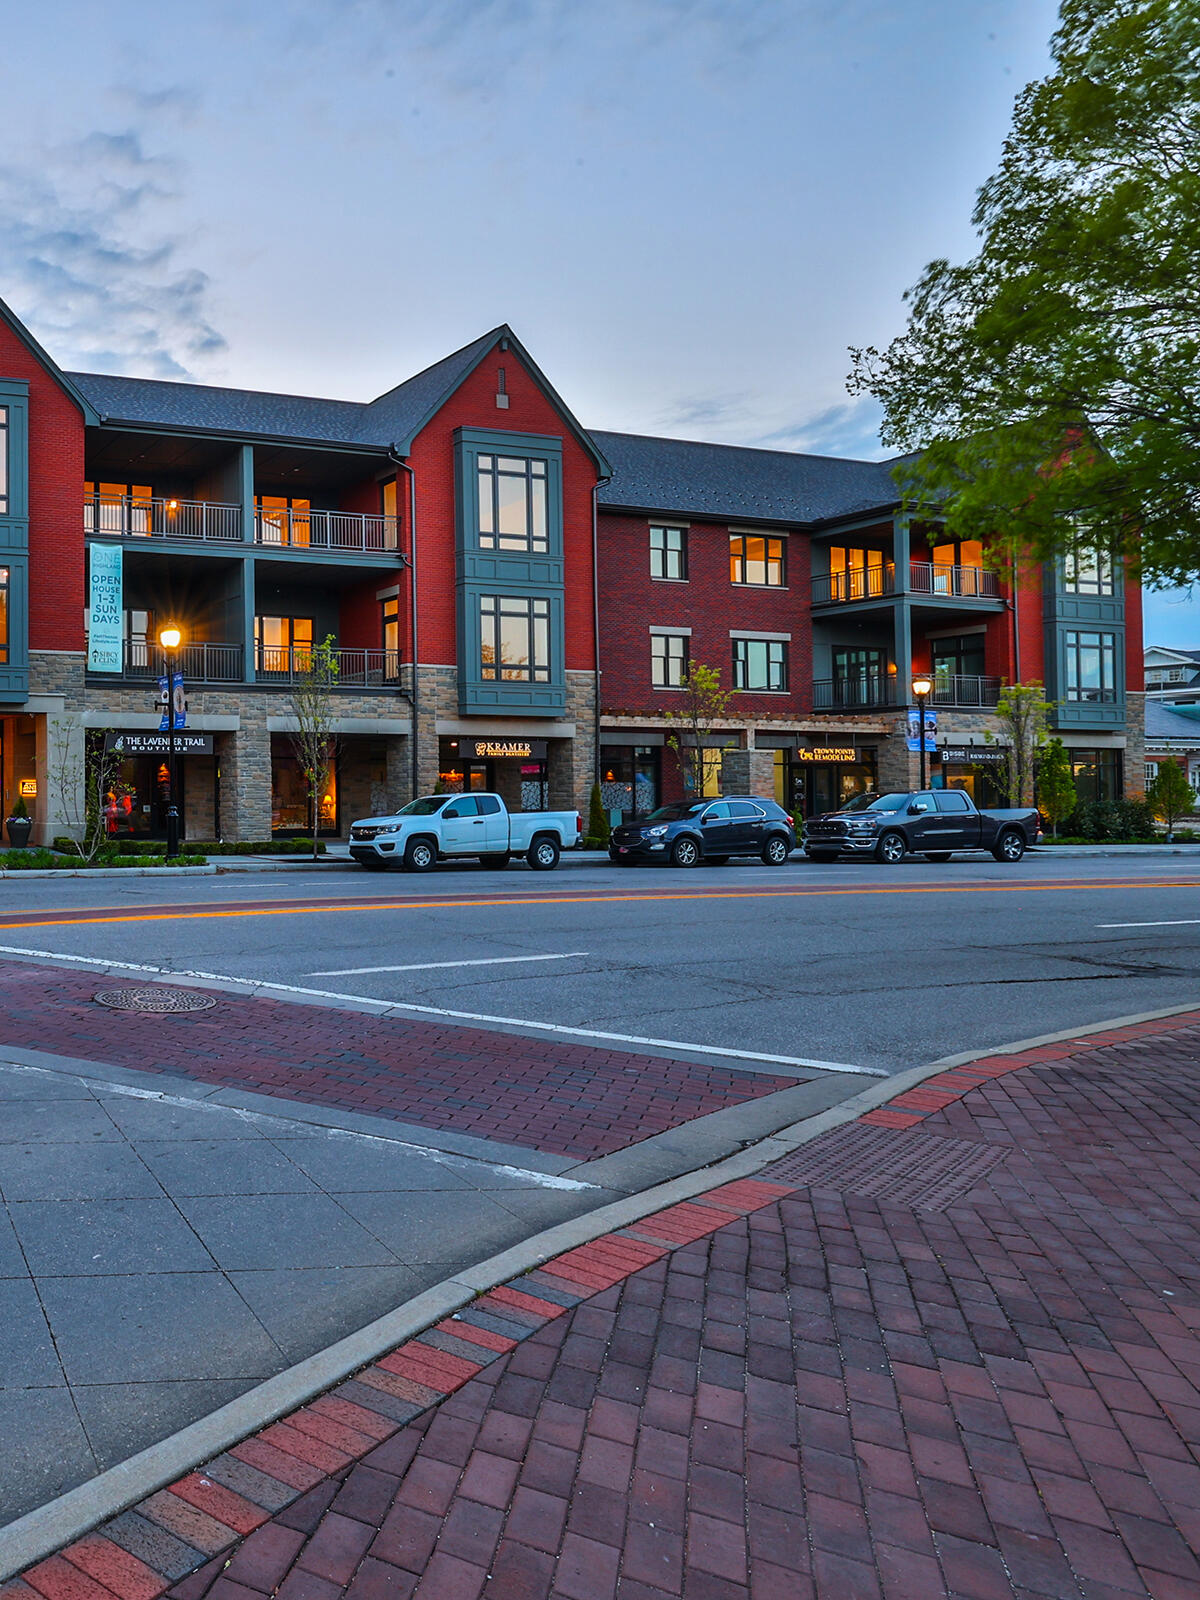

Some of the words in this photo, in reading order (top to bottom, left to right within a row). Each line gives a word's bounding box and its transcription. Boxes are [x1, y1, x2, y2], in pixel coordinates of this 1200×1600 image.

[93, 552, 120, 563] ONE
[91, 574, 121, 585] OPEN
[92, 585, 120, 593] HOUSE
[95, 604, 117, 614] SUN
[92, 614, 120, 624] DAYS
[125, 736, 141, 745] THE
[143, 737, 182, 746] LAVENER
[184, 737, 205, 746] TRAIL
[486, 742, 531, 751] KRAMER
